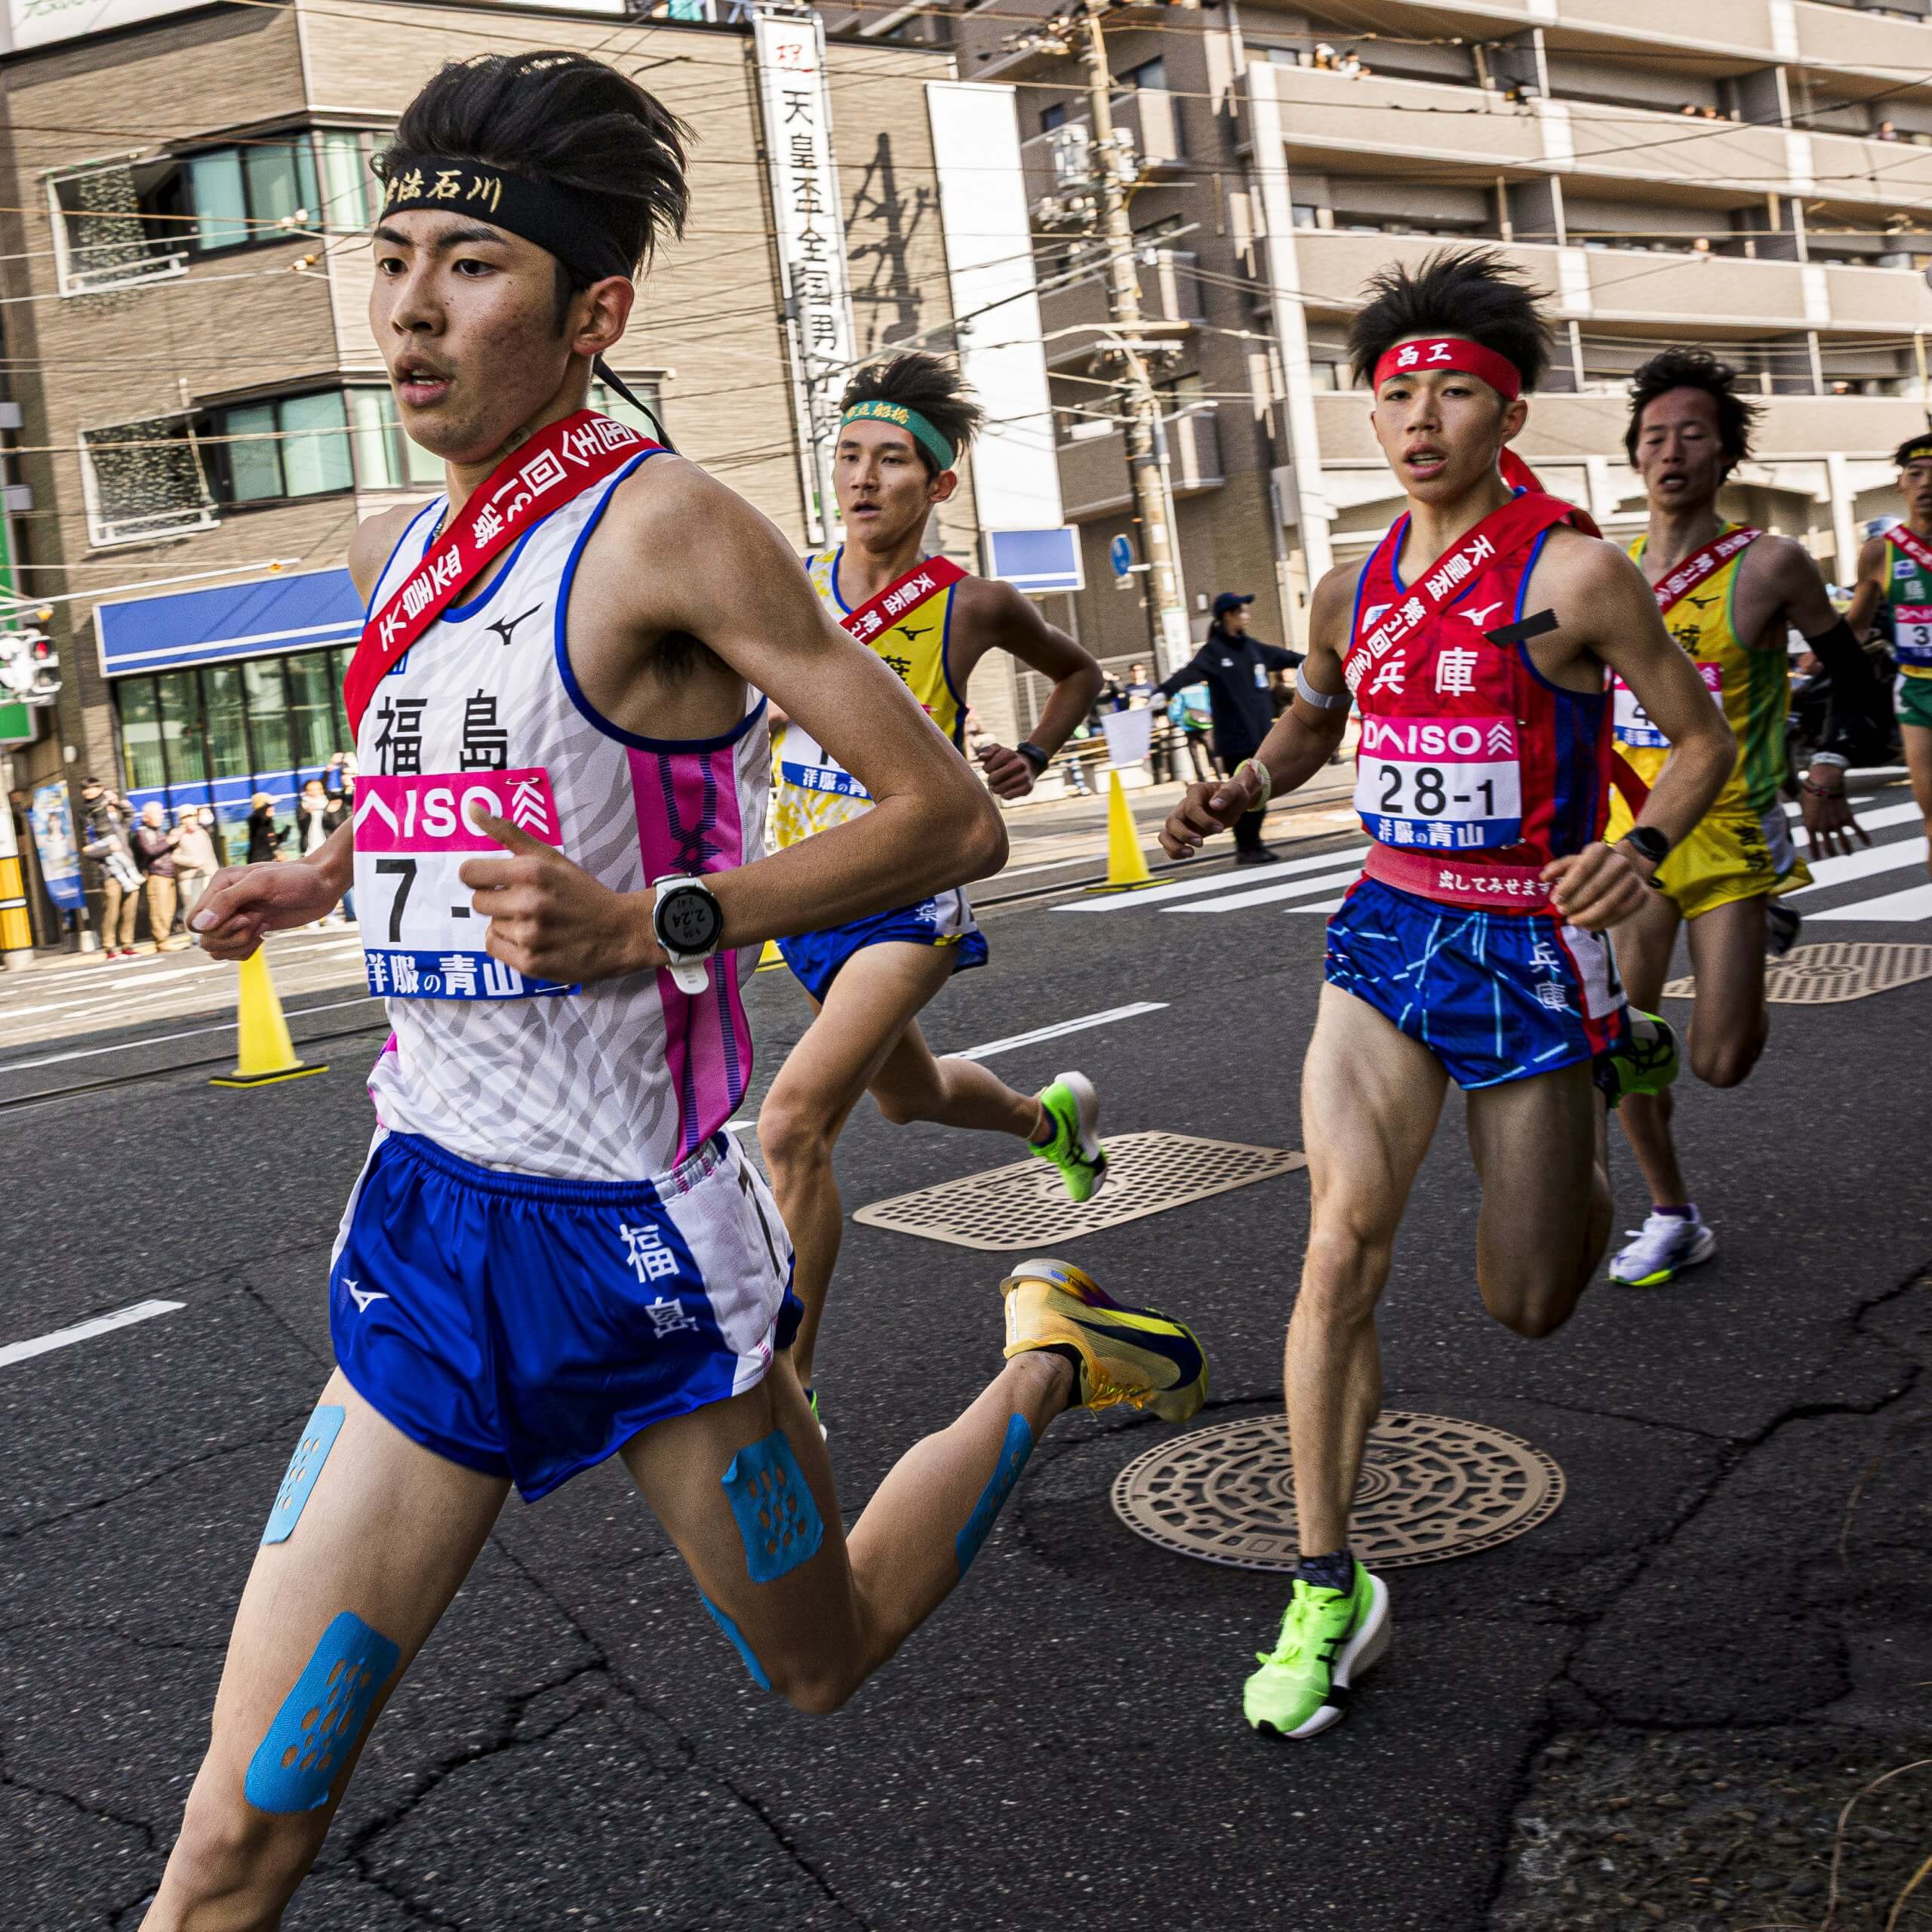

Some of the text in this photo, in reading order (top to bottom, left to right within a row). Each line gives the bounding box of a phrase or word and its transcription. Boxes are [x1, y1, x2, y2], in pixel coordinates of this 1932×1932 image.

[472, 417, 651, 549] 第31回全国
[850, 610, 883, 641] 第31
[1368, 647, 1478, 697] 兵庫
[374, 688, 508, 776] 福島
[1363, 720, 1482, 755] DAISO
[803, 768, 868, 797] 洋服の青
[1379, 764, 1494, 816] 28-1
[352, 786, 503, 838] AISO
[1378, 817, 1484, 848] 洋服の青山
[376, 859, 471, 943] 7-
[365, 953, 525, 996] 洋服の青山
[1528, 942, 1568, 1012] 兵庫
[620, 1223, 700, 1340] 福島
